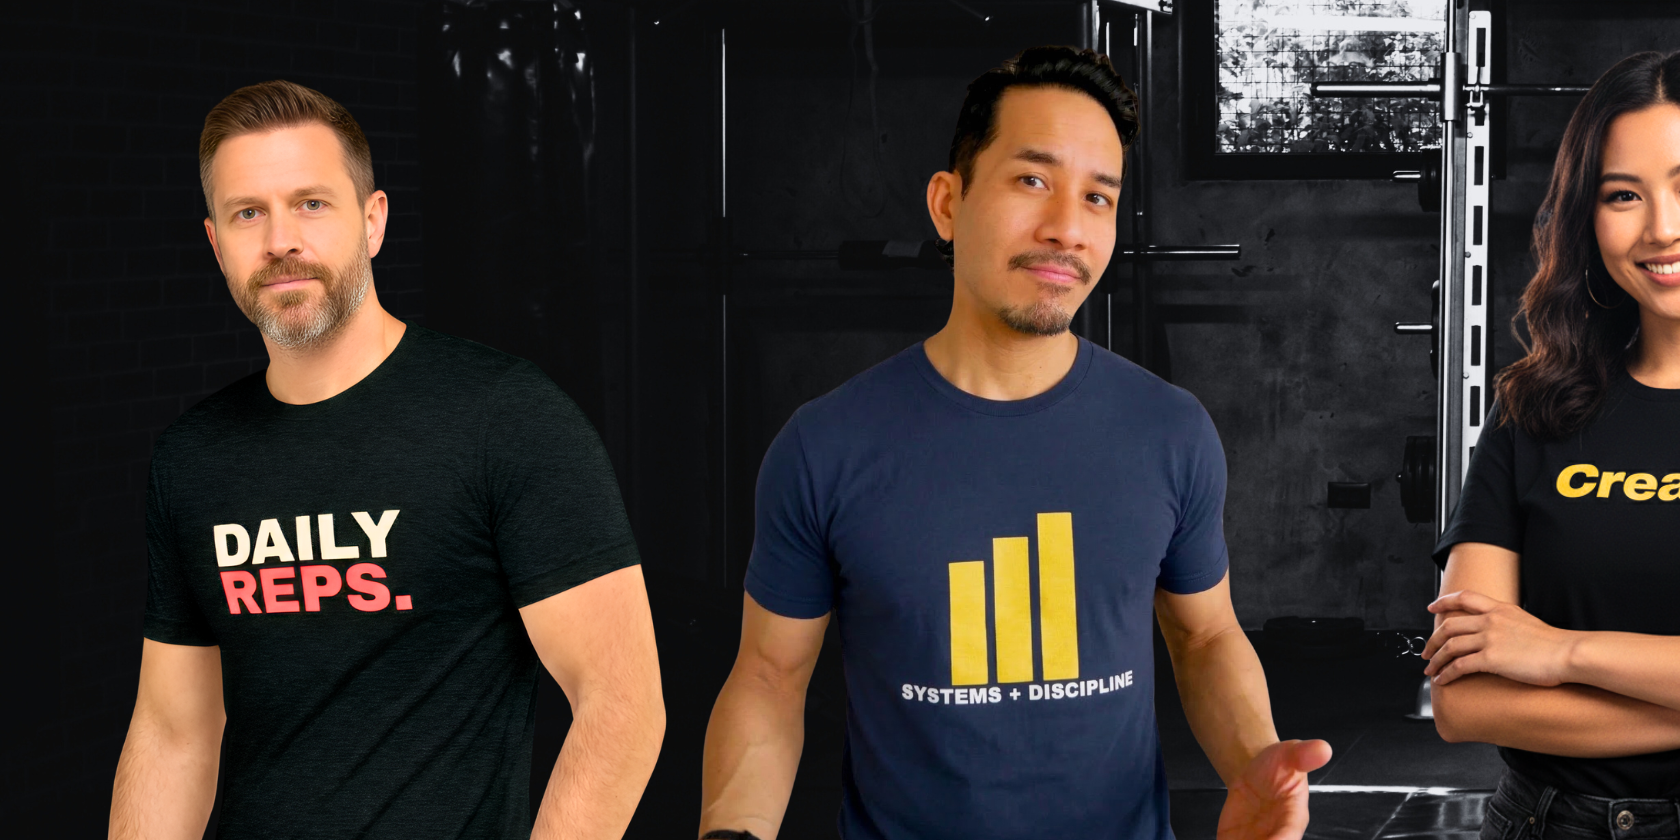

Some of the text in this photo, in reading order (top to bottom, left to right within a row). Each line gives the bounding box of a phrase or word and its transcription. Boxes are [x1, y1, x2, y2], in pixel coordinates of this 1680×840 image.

[214, 510, 400, 567] DAILY
[220, 563, 412, 615] REPS.
[902, 684, 1002, 705] SYSTEMS
[1029, 670, 1133, 701] DISCIPLINE
